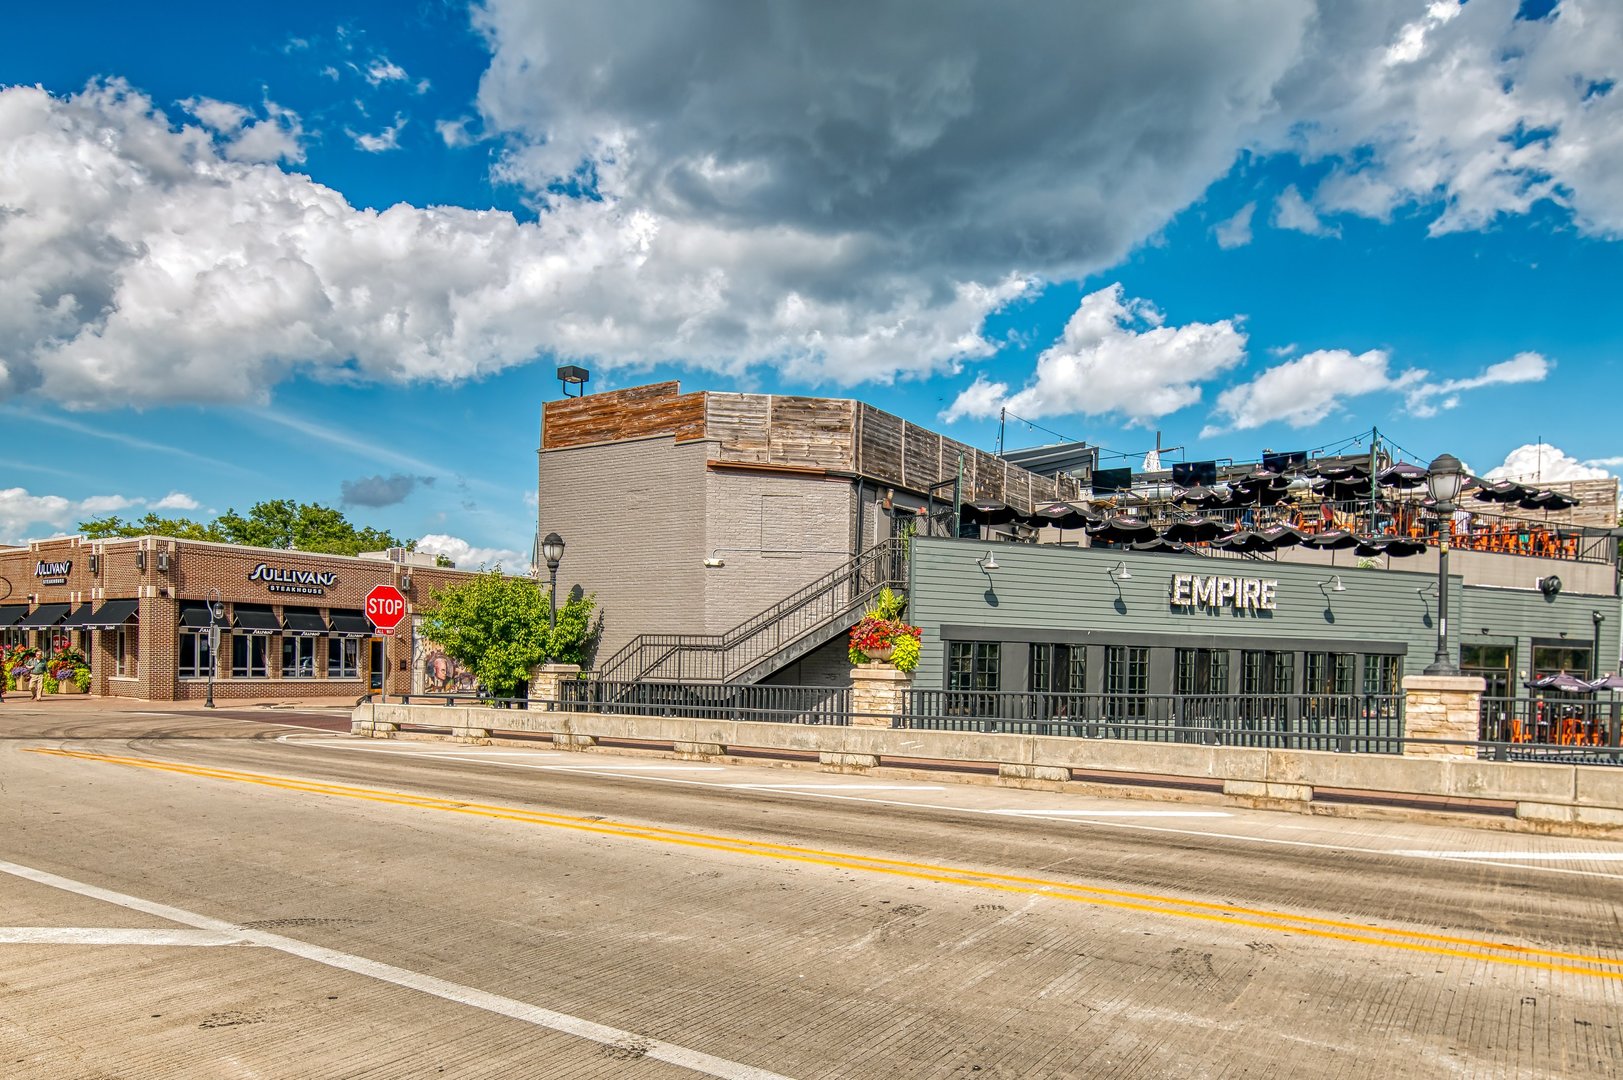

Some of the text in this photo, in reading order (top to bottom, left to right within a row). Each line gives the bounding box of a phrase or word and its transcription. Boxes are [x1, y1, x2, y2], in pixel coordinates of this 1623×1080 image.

[250, 564, 337, 586] SULLIVAN'S
[270, 585, 322, 594] STEAKHOUSE
[1171, 574, 1278, 609] EMPIRE
[368, 597, 403, 616] STOP
